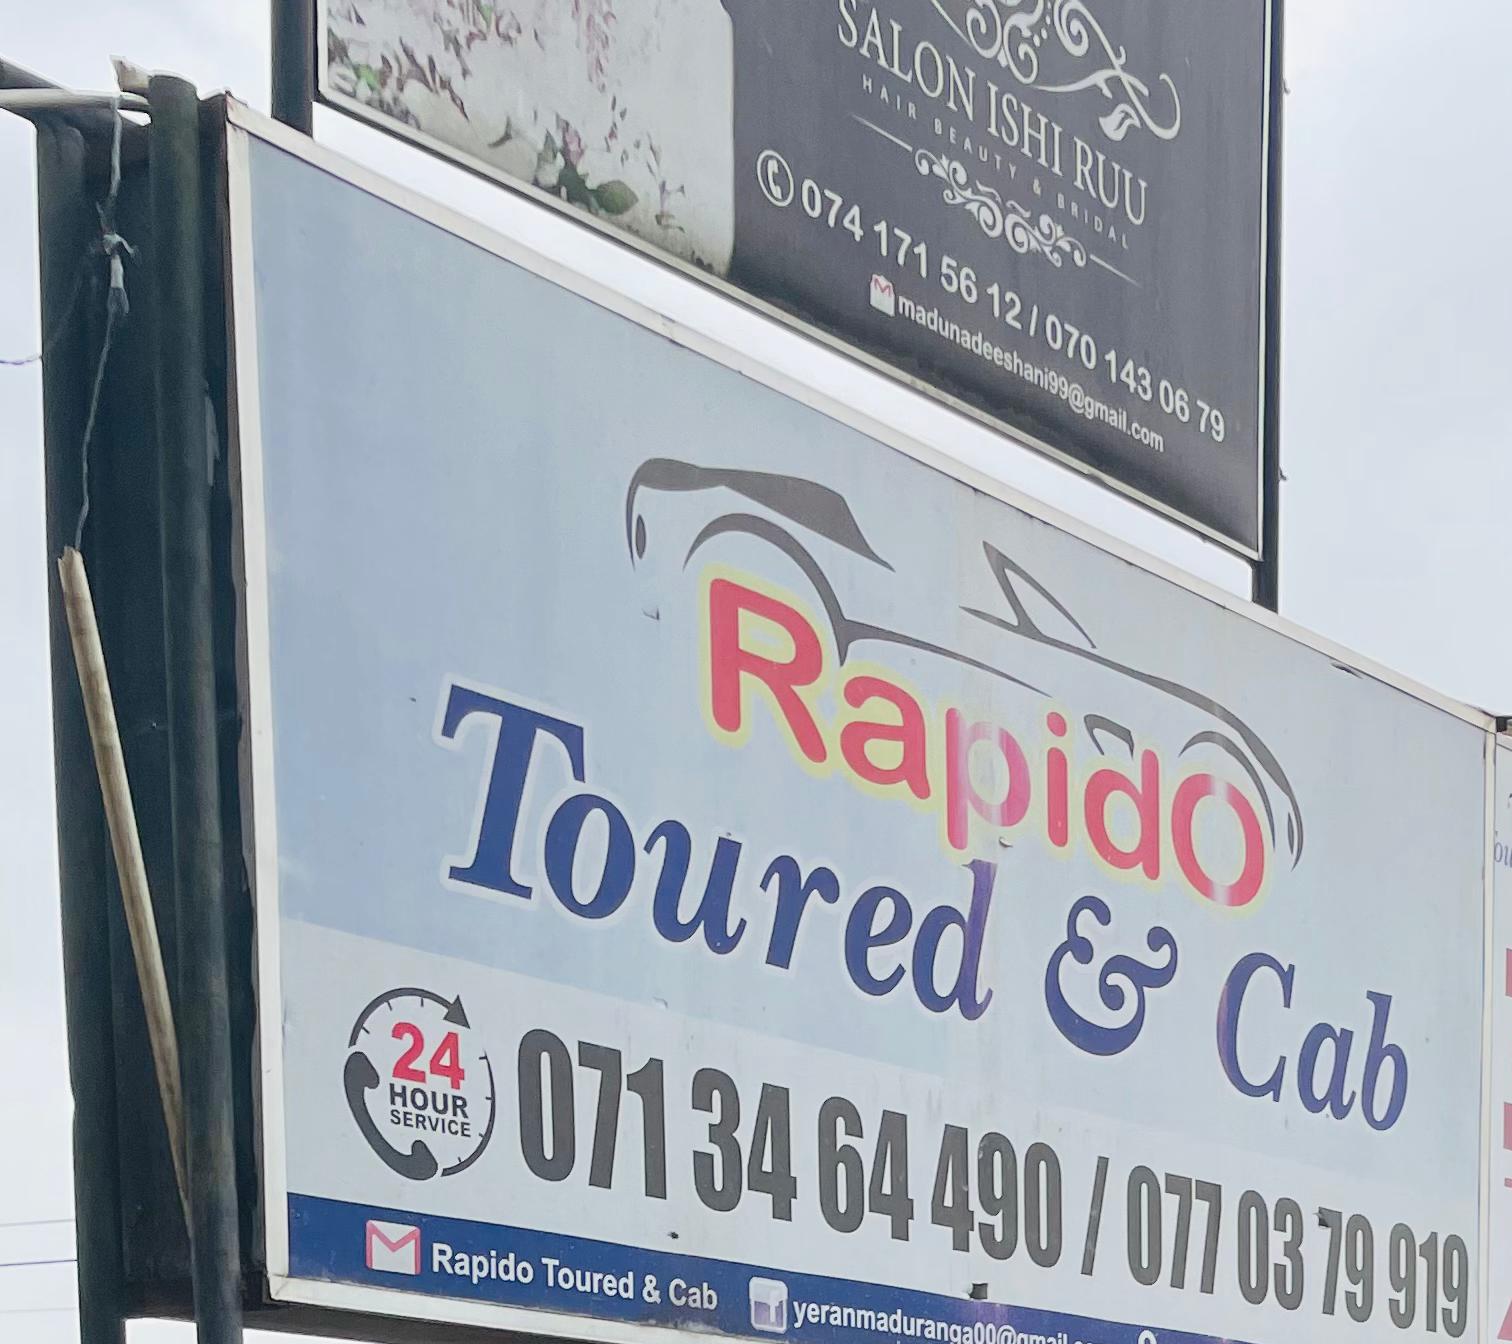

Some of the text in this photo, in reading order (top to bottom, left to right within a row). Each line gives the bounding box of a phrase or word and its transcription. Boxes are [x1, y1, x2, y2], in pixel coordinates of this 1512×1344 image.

[837, 0, 1148, 226] SALON ISHI RUU
[862, 74, 1130, 250] HAIR BEAUTY & BRIDAL
[801, 179, 1225, 443] 074 171 56 12 / 070 143 06 79
[898, 291, 1165, 454] madunadeeshani99@gmail.com
[440, 684, 1410, 1131] Toured & Cab
[389, 1083, 468, 1119] HOUR
[390, 1109, 471, 1138] SERVICE
[391, 1021, 465, 1091] 24
[518, 1028, 1469, 1339] 071 34 64 490 / 077 03 79 919
[431, 1242, 719, 1311] Rapido Toured & Cab
